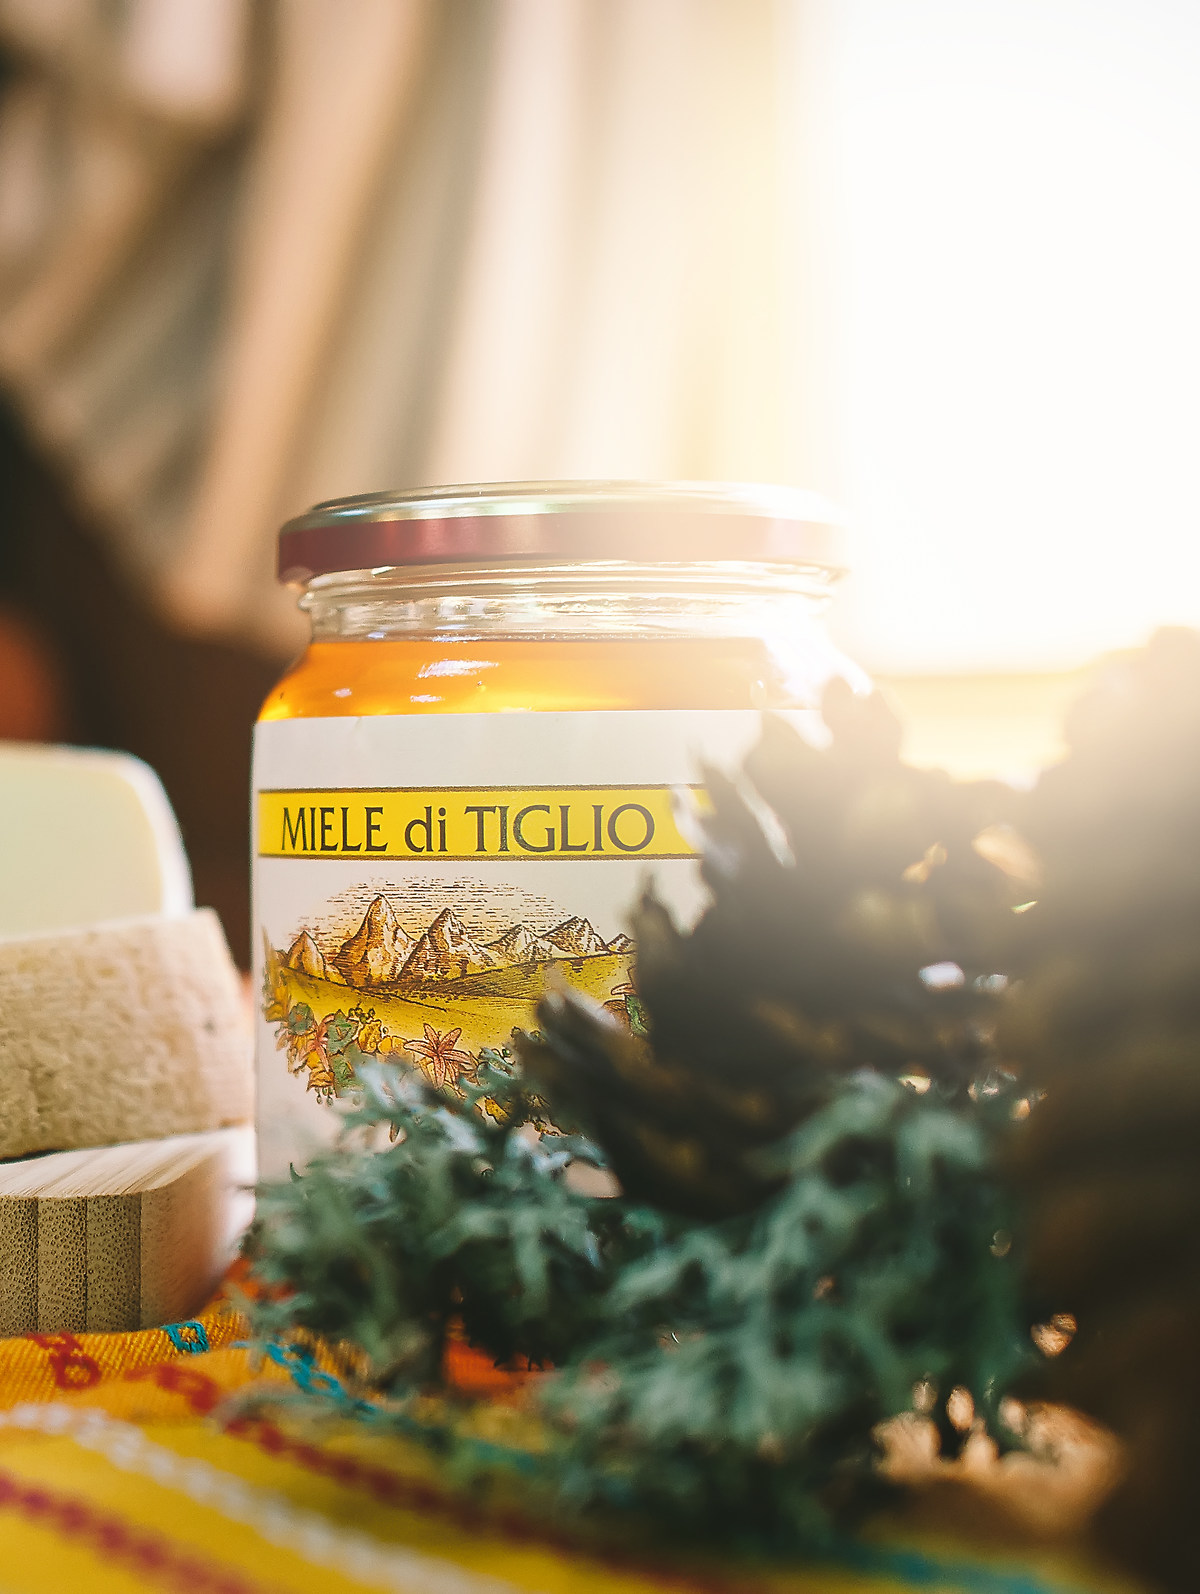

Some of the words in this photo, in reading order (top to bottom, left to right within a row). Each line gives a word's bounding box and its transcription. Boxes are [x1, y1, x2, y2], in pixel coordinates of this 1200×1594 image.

[280, 805, 389, 852] MIELE
[404, 805, 448, 853] di
[464, 802, 656, 853] TIGLIO
